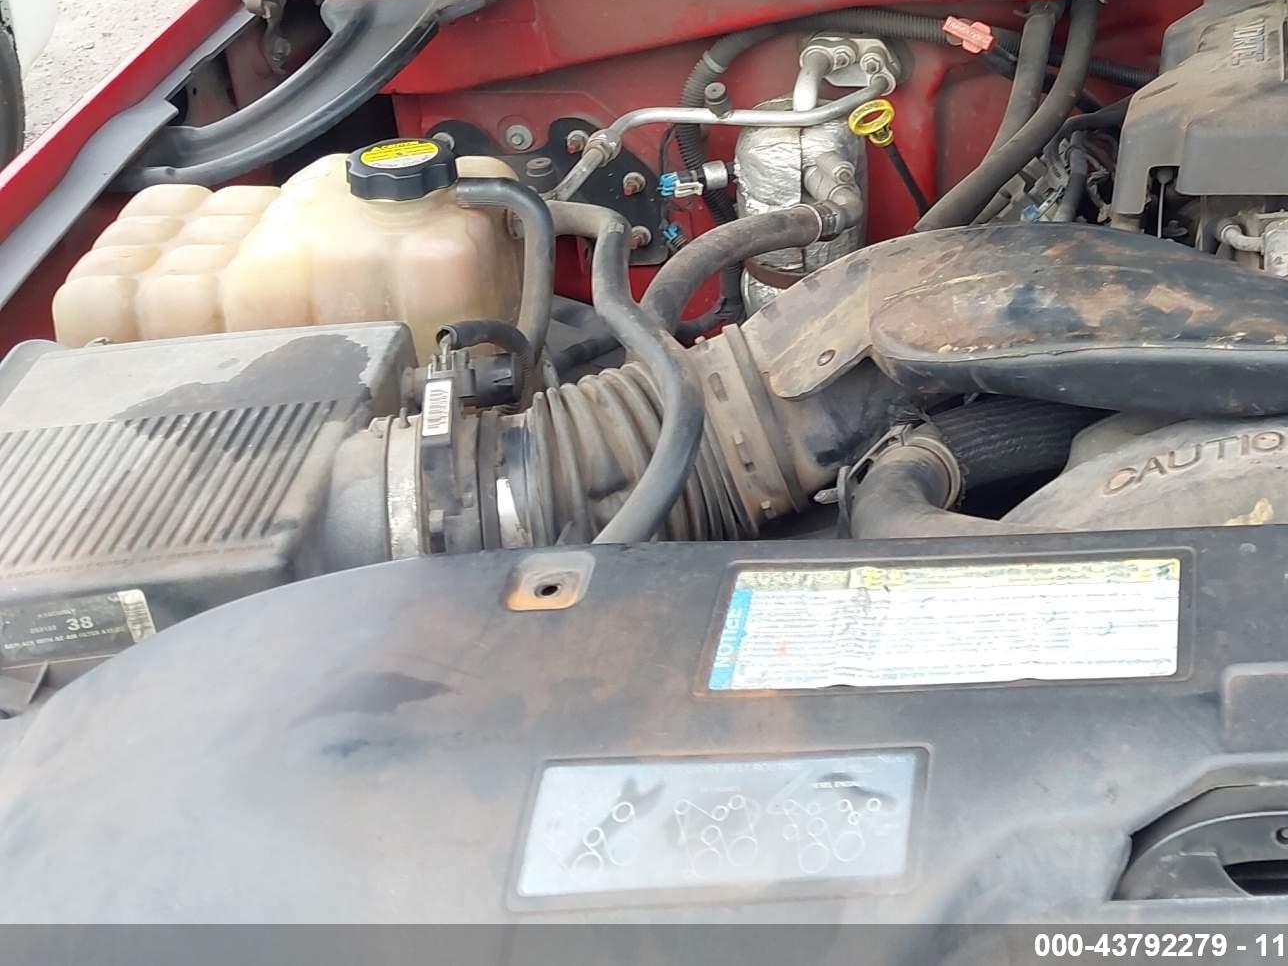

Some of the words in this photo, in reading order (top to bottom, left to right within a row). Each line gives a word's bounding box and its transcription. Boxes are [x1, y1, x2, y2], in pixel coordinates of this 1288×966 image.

[1231, 18, 1266, 66] VORTEC
[65, 616, 94, 631] 38
[713, 608, 742, 668] NOTICE
